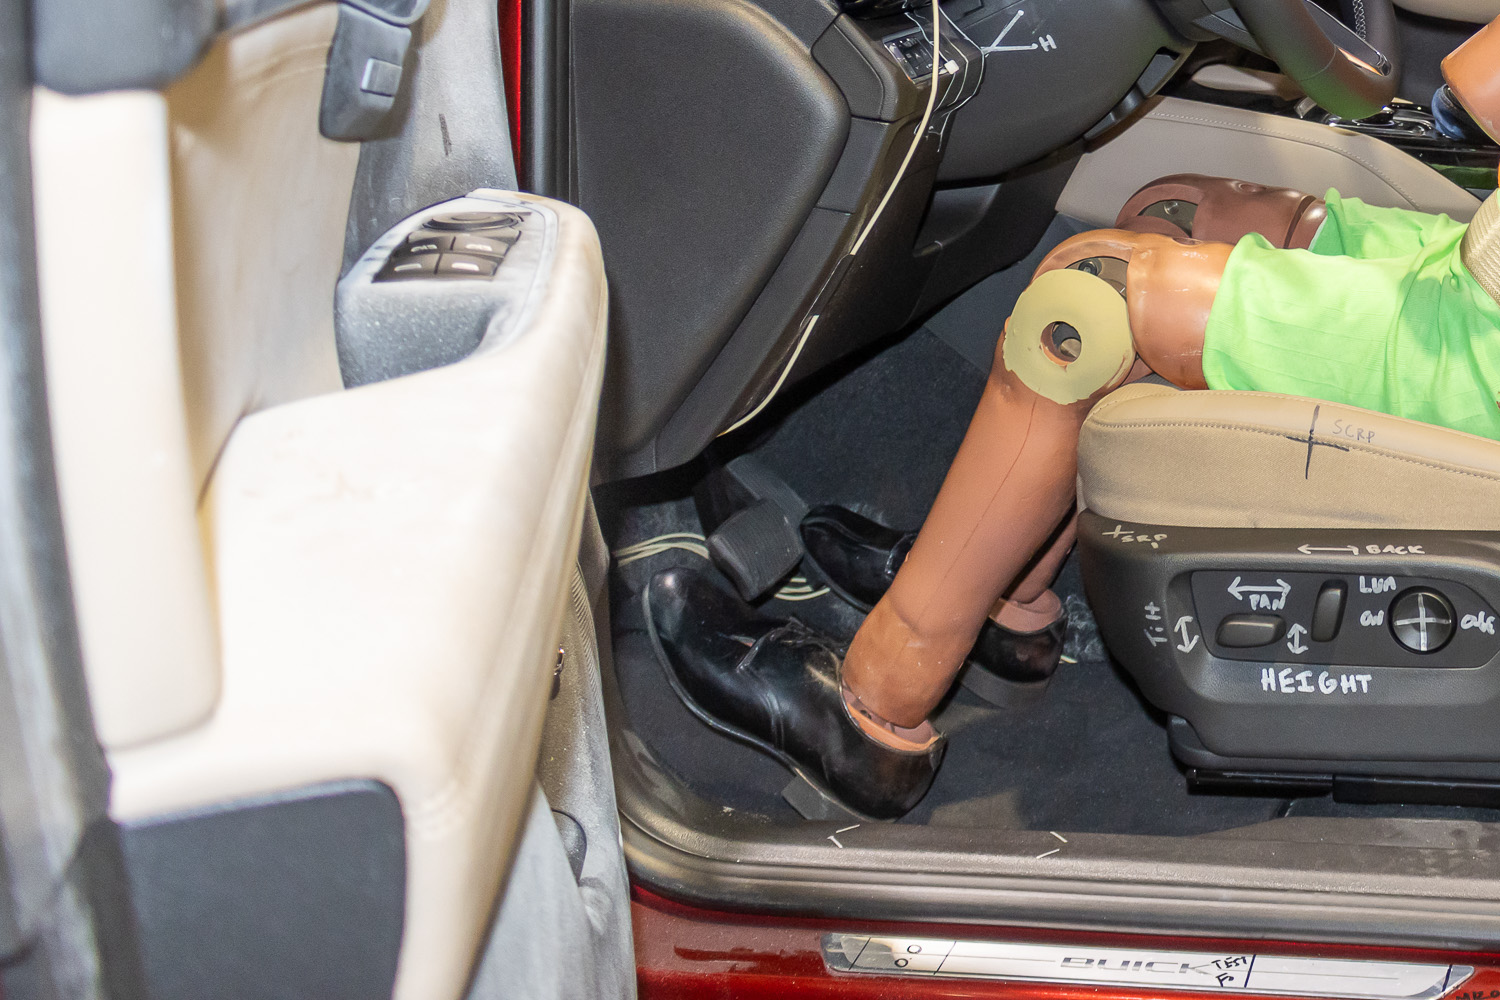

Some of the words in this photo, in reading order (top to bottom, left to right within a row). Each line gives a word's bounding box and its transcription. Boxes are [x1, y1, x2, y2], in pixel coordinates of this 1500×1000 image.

[1366, 544, 1426, 555] BACK
[1260, 667, 1373, 694] HEIGHT
[1061, 956, 1214, 975] BUICK
[1211, 956, 1248, 970] TEST
